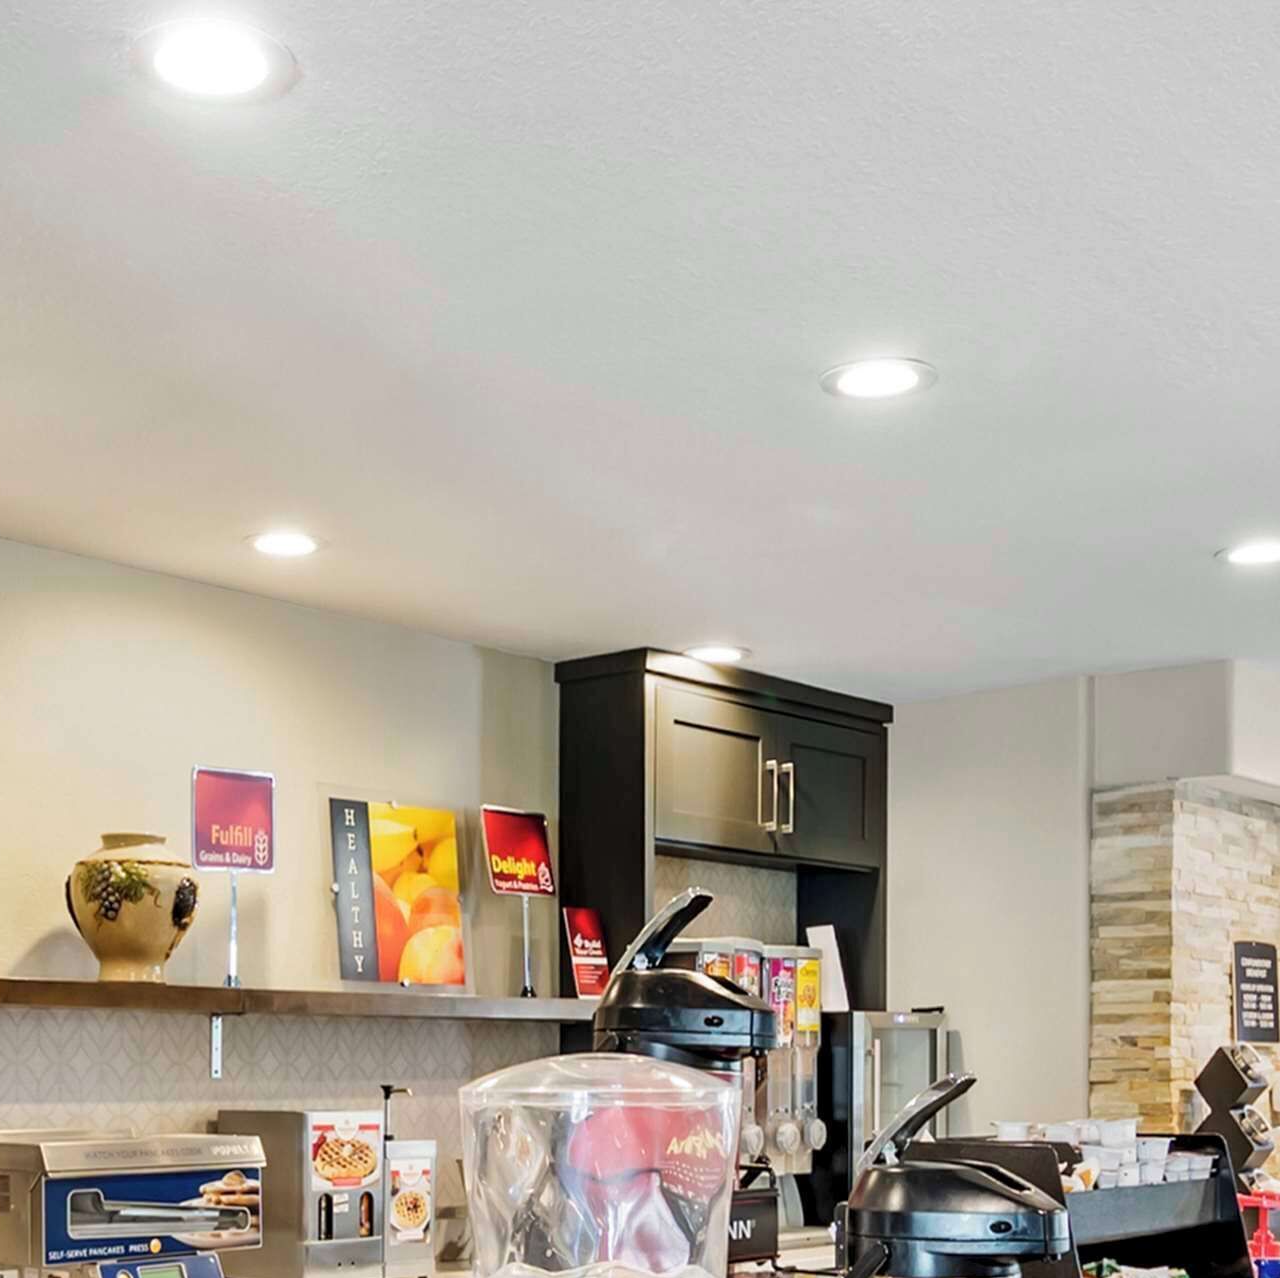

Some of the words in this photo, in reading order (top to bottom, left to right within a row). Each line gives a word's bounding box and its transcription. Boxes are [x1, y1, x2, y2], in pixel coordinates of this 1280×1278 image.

[211, 824, 253, 847] Fulfill
[200, 850, 224, 863] Grains
[225, 852, 231, 863] &
[232, 852, 253, 866] Dairy
[491, 854, 537, 880] Delight
[344, 808, 364, 973] HEALTHY
[728, 1219, 752, 1241] NN
[48, 1248, 88, 1260] SELF-SERVE
[89, 1245, 125, 1256] PANCAKES
[129, 1244, 149, 1253] PRESS
